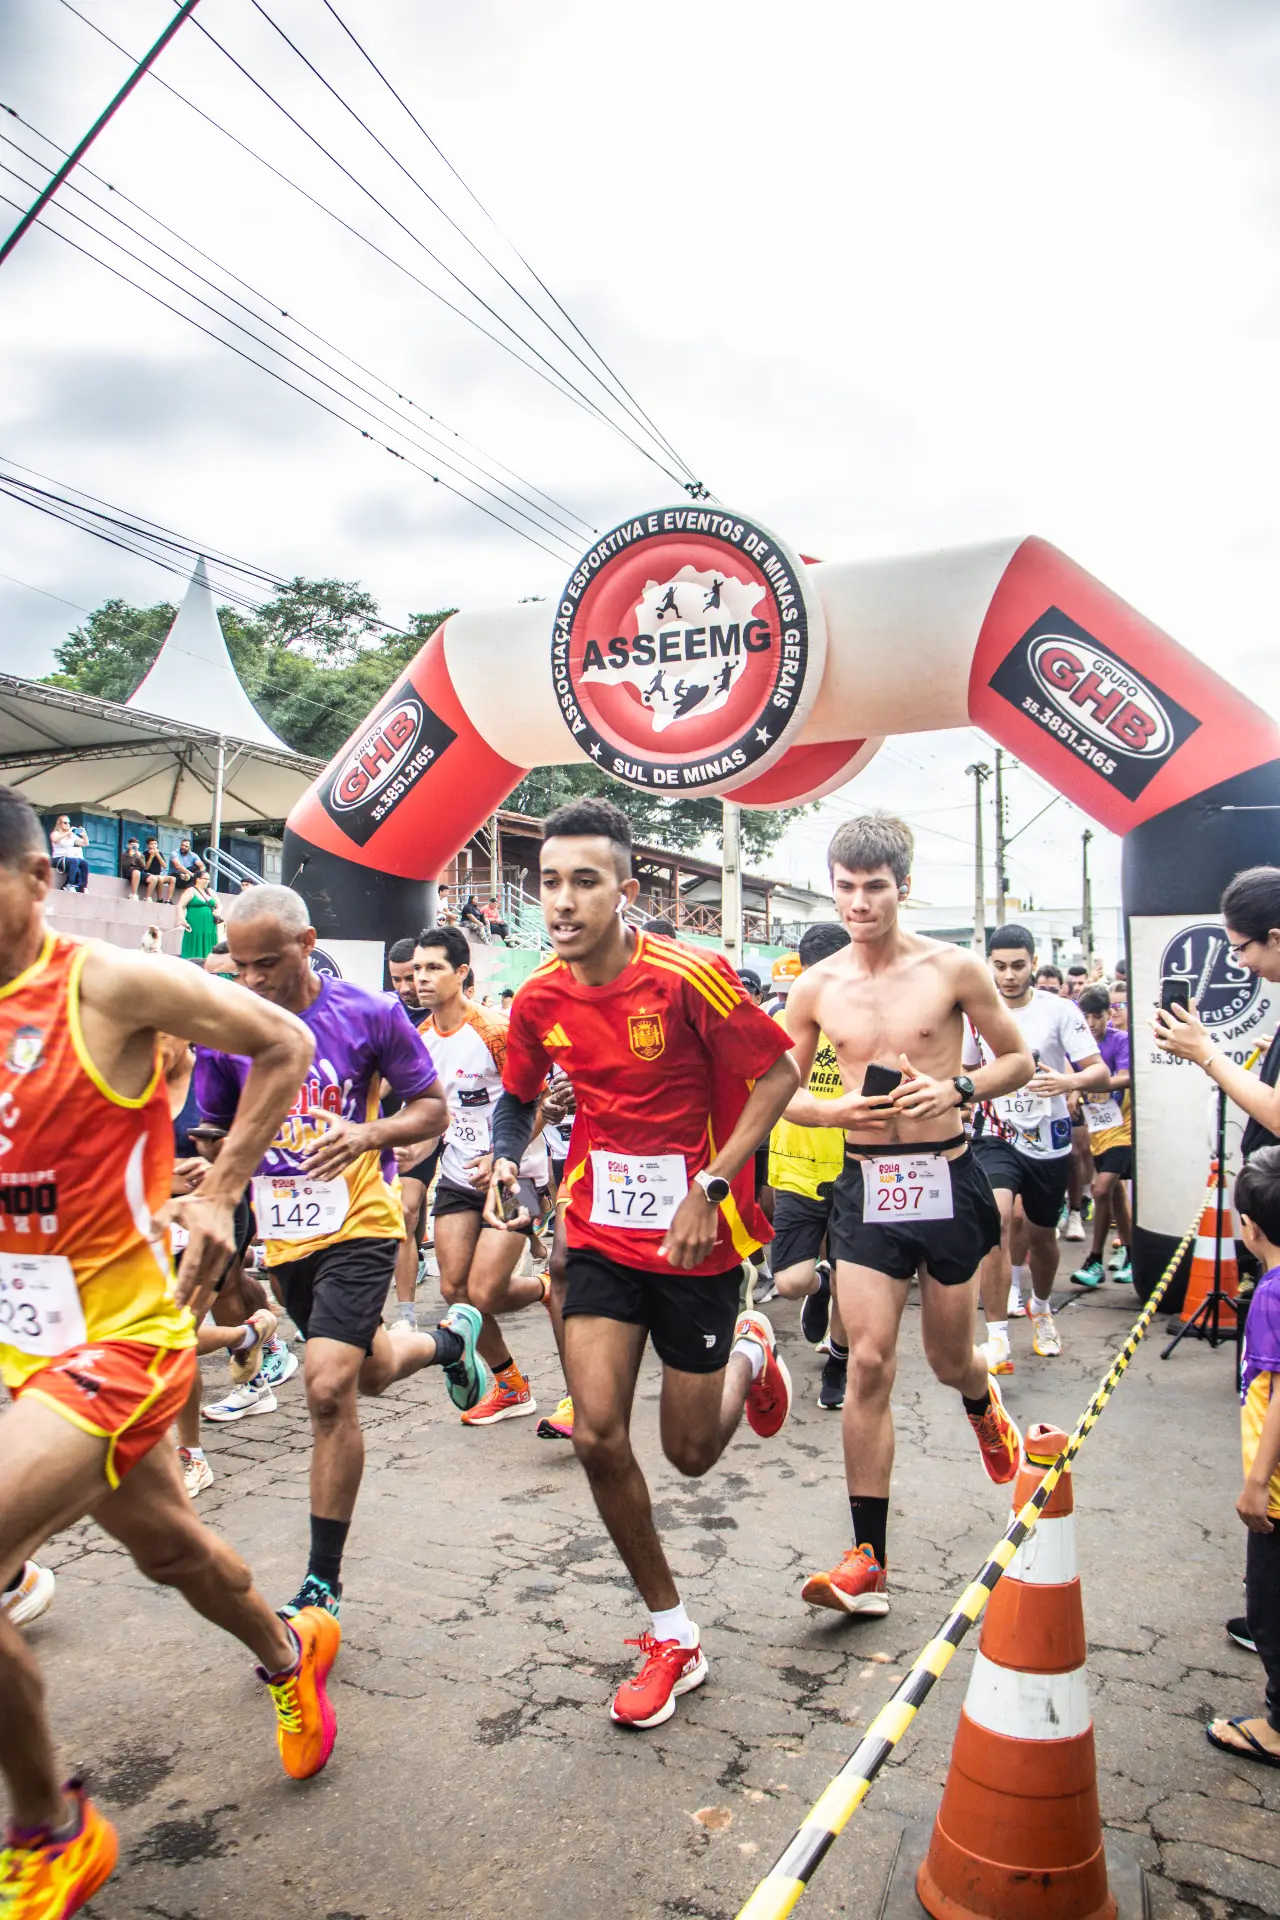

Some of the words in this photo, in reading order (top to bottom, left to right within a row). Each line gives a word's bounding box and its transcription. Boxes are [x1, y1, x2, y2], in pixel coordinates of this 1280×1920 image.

[647, 512, 659, 532] E
[663, 511, 745, 542] EVENTOS
[569, 520, 644, 600] ESPORTIVA
[743, 532, 769, 560] DE
[762, 554, 798, 622] MINAS
[582, 619, 771, 672] ASSEEMG
[554, 601, 587, 735] ASSOCIAÇÃO
[772, 629, 801, 710] GERAIS
[1092, 659, 1138, 698] GRUPO
[1038, 647, 1158, 750] GHB
[354, 726, 382, 761] GRUPO
[1021, 696, 1117, 775] 35.3851.2165
[340, 711, 416, 802] GHB
[612, 757, 648, 782] SUL
[653, 767, 679, 784] DE
[683, 749, 747, 784] MINAS
[370, 745, 435, 821] 35.3851.2165
[1223, 998, 1271, 1040] VAREJO
[810, 1072, 843, 1086] NGER
[1005, 1099, 1034, 1113] 167
[1091, 1112, 1113, 1126] 248
[270, 1202, 321, 1227] 142
[607, 1188, 658, 1217] 172
[877, 1186, 924, 1211] 297
